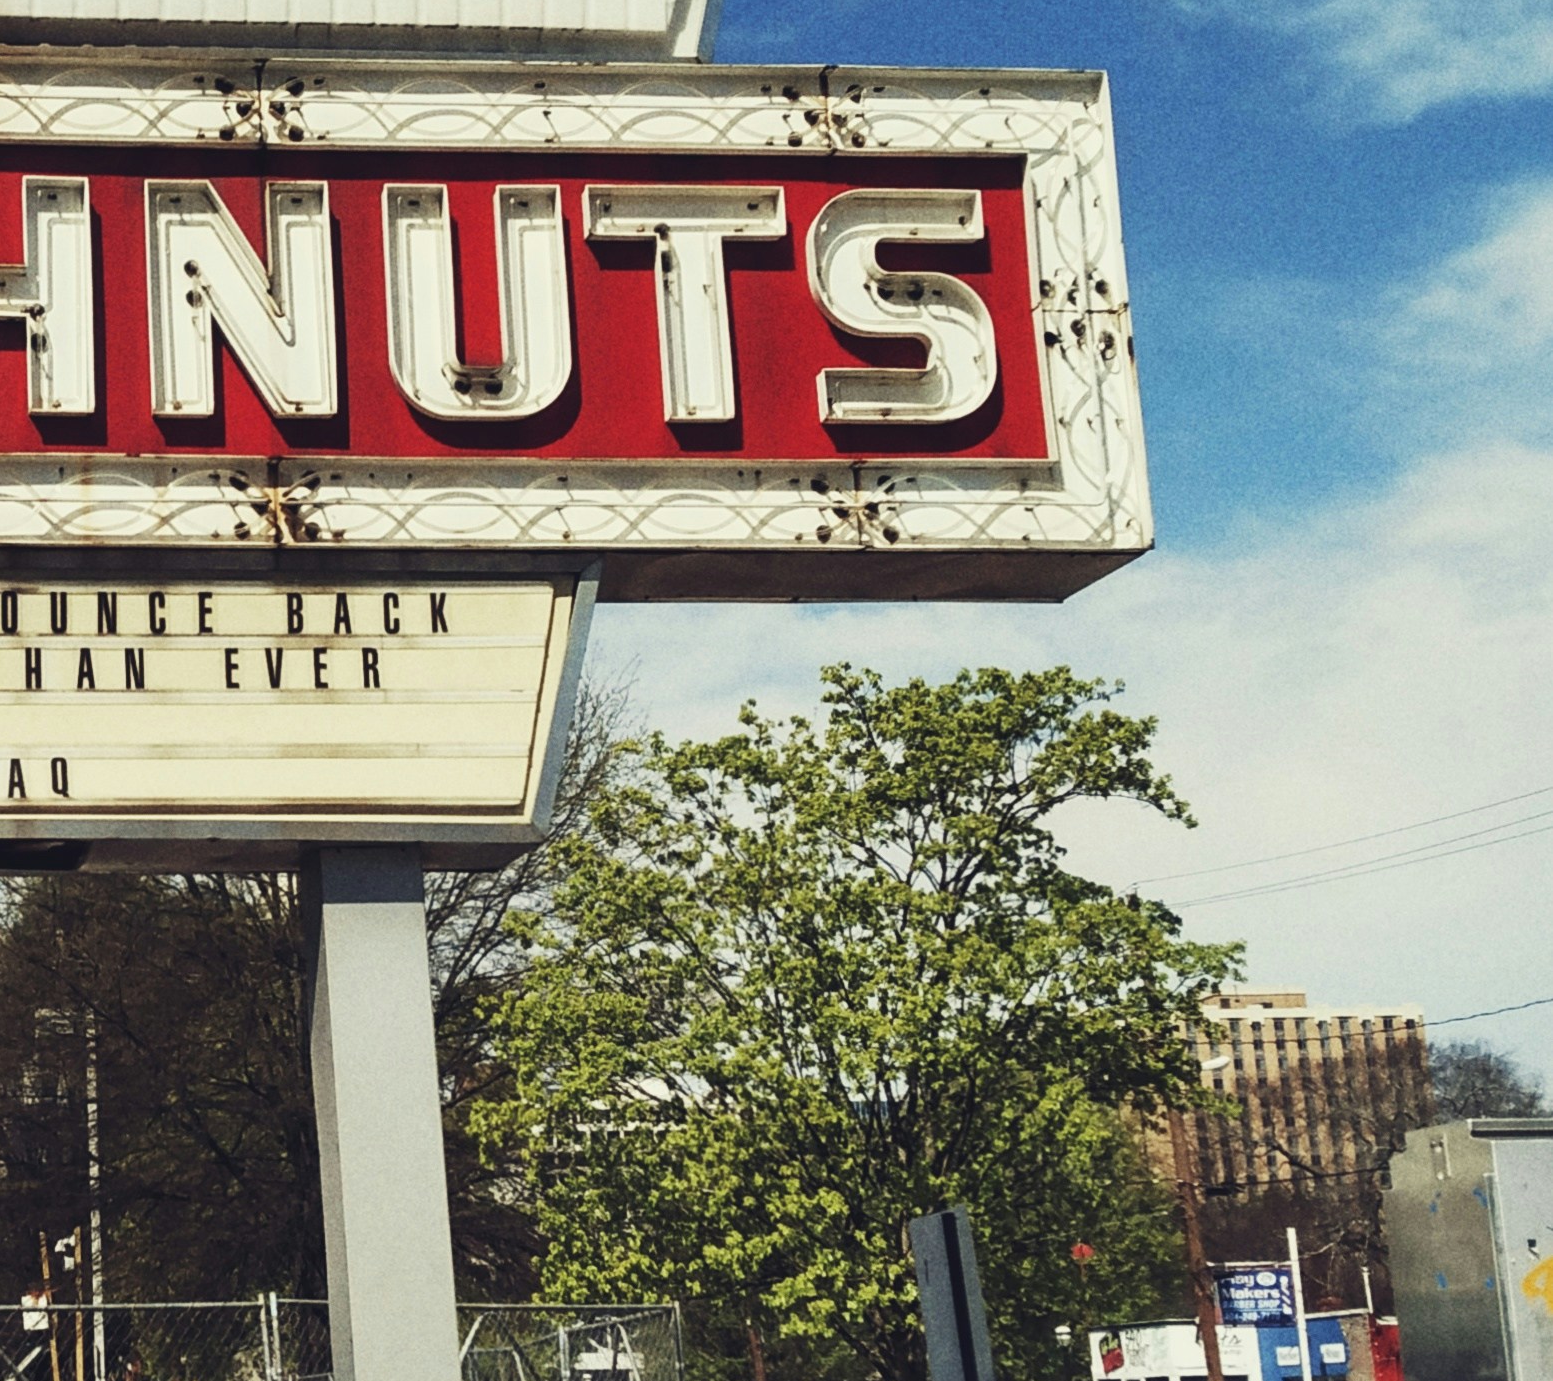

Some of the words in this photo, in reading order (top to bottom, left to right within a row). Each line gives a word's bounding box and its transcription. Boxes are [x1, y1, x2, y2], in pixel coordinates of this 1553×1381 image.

[285, 590, 450, 637] BACK
[224, 646, 382, 691] EVER
[1221, 1287, 1281, 1300] Makers
[1257, 1299, 1281, 1309] SHOP
